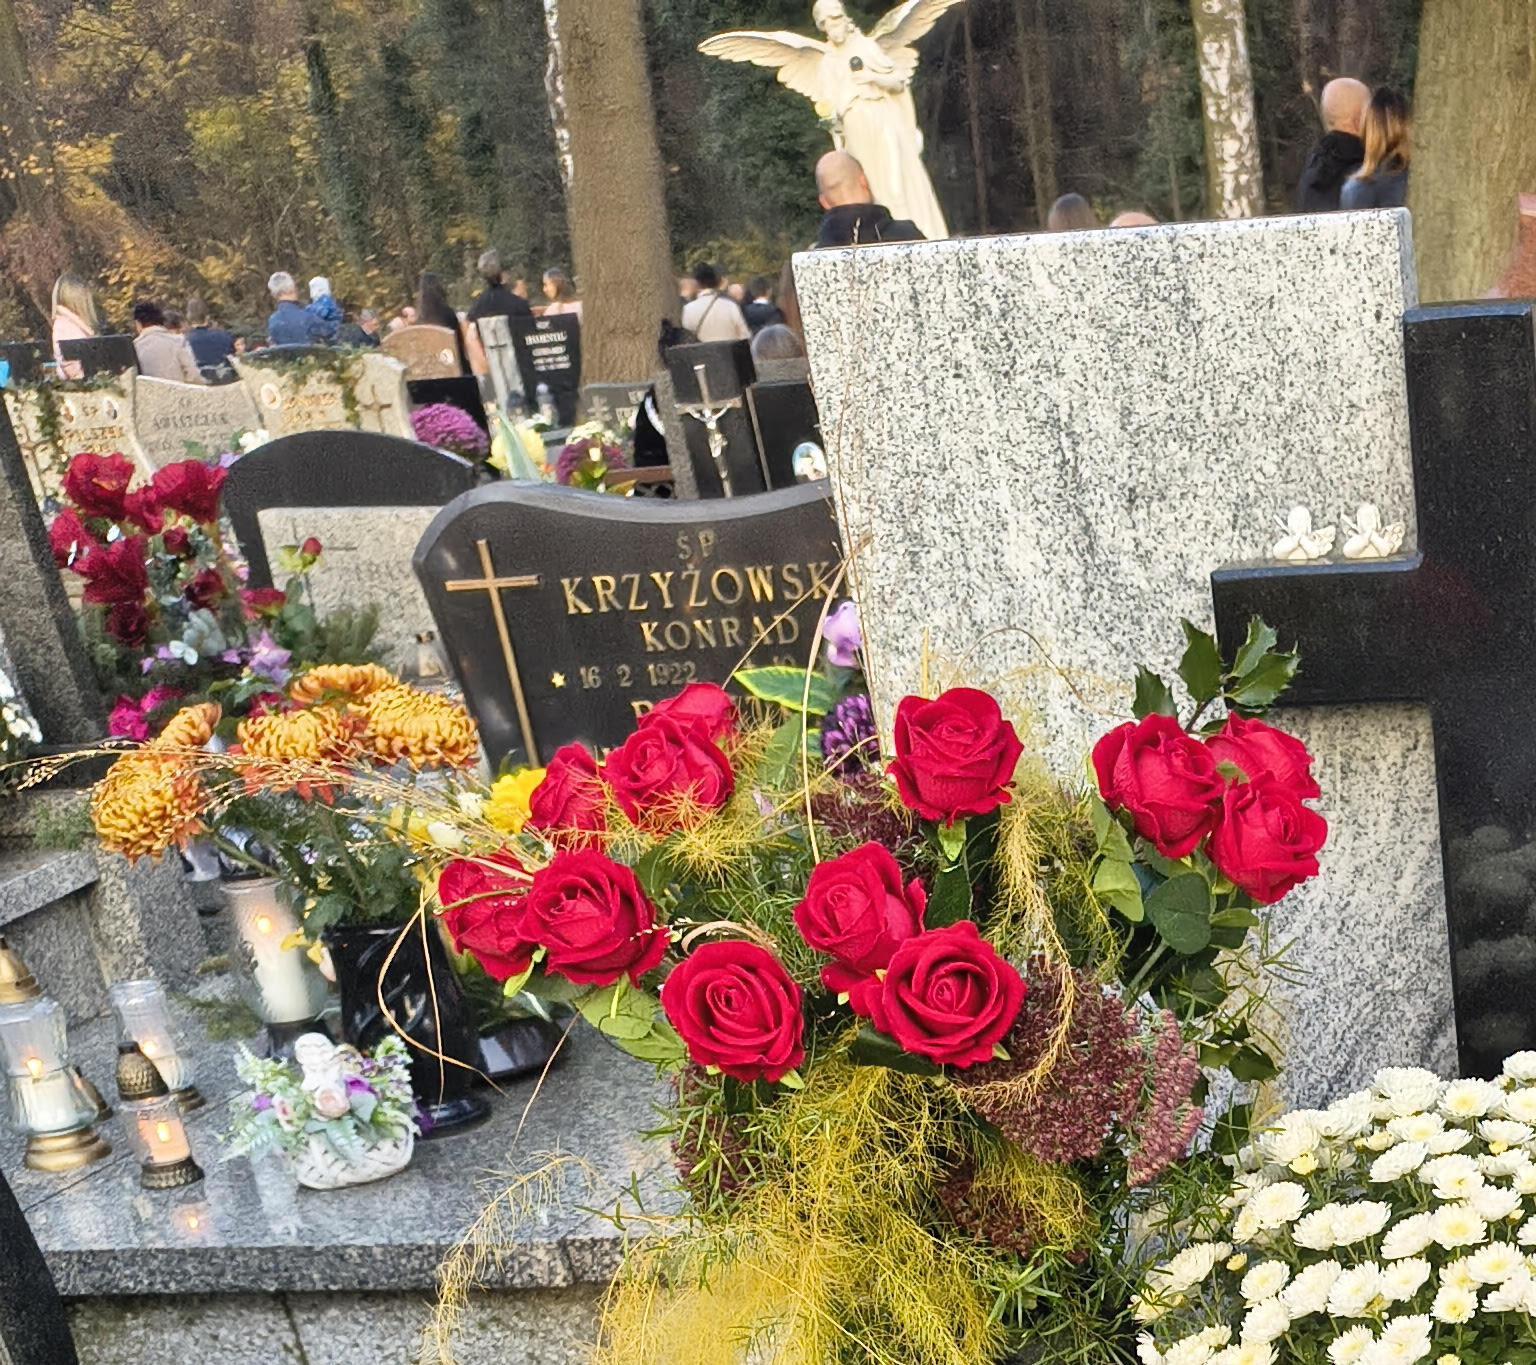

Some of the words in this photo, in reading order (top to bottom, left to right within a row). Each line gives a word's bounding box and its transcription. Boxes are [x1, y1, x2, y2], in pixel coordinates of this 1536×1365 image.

[640, 614, 800, 651] KONRAD
[580, 665, 601, 689] 16
[617, 663, 633, 687] 2
[648, 660, 699, 686] 1922
